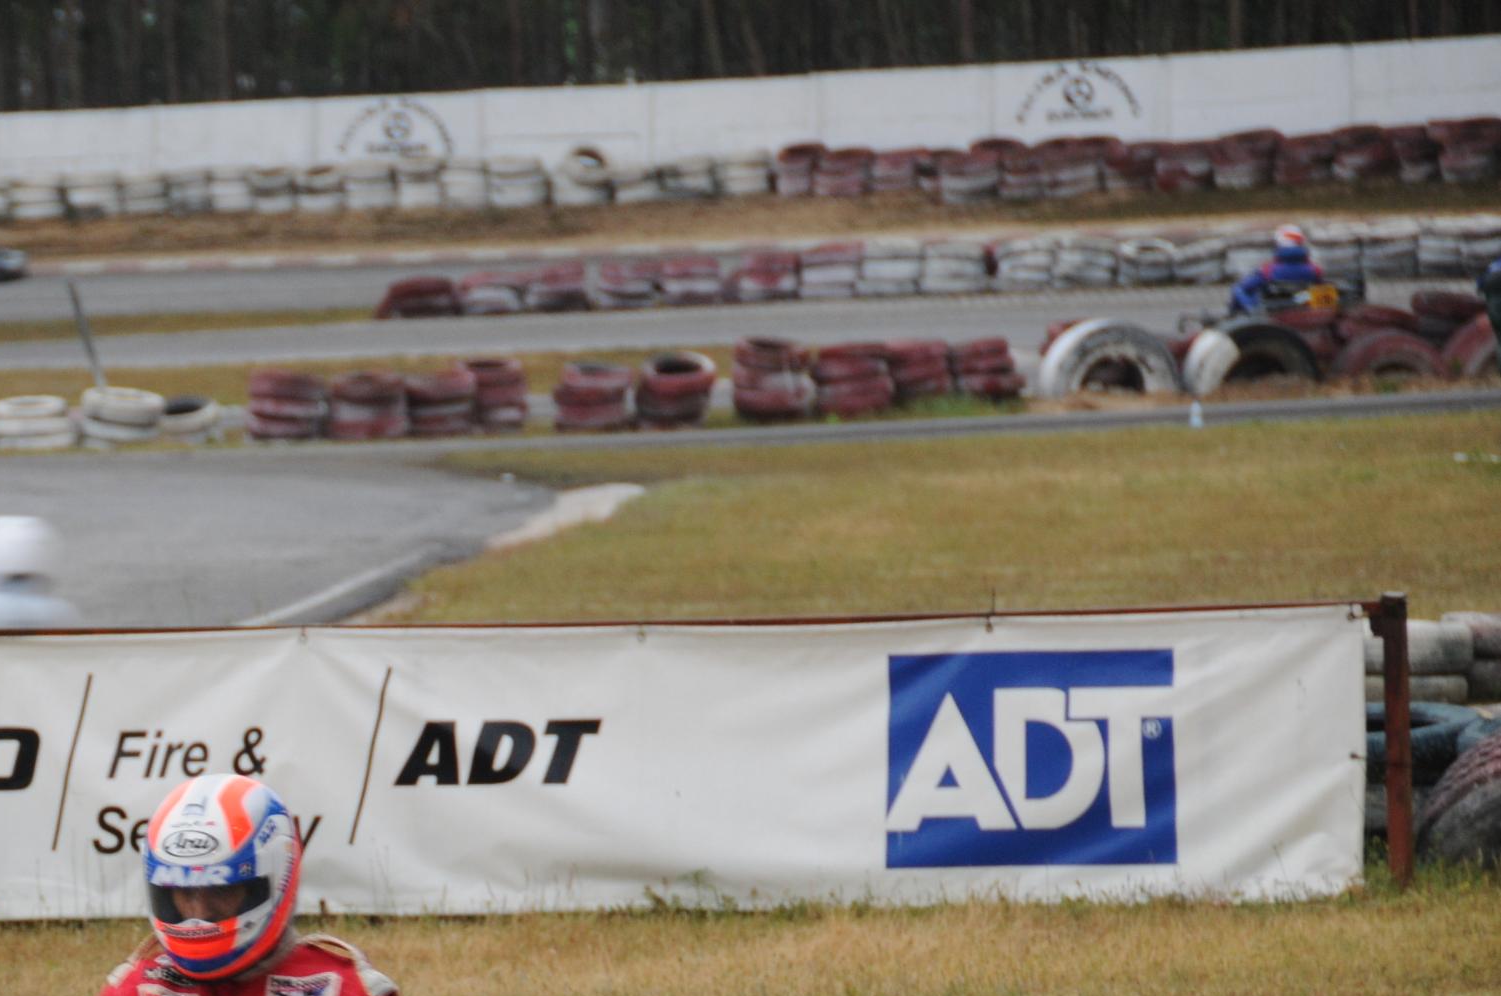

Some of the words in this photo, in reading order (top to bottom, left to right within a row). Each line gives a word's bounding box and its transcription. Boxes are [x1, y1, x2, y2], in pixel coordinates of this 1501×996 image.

[108, 729, 208, 779] Fire
[233, 727, 267, 776] &
[394, 719, 601, 786] ADT
[887, 685, 1174, 831] ADT
